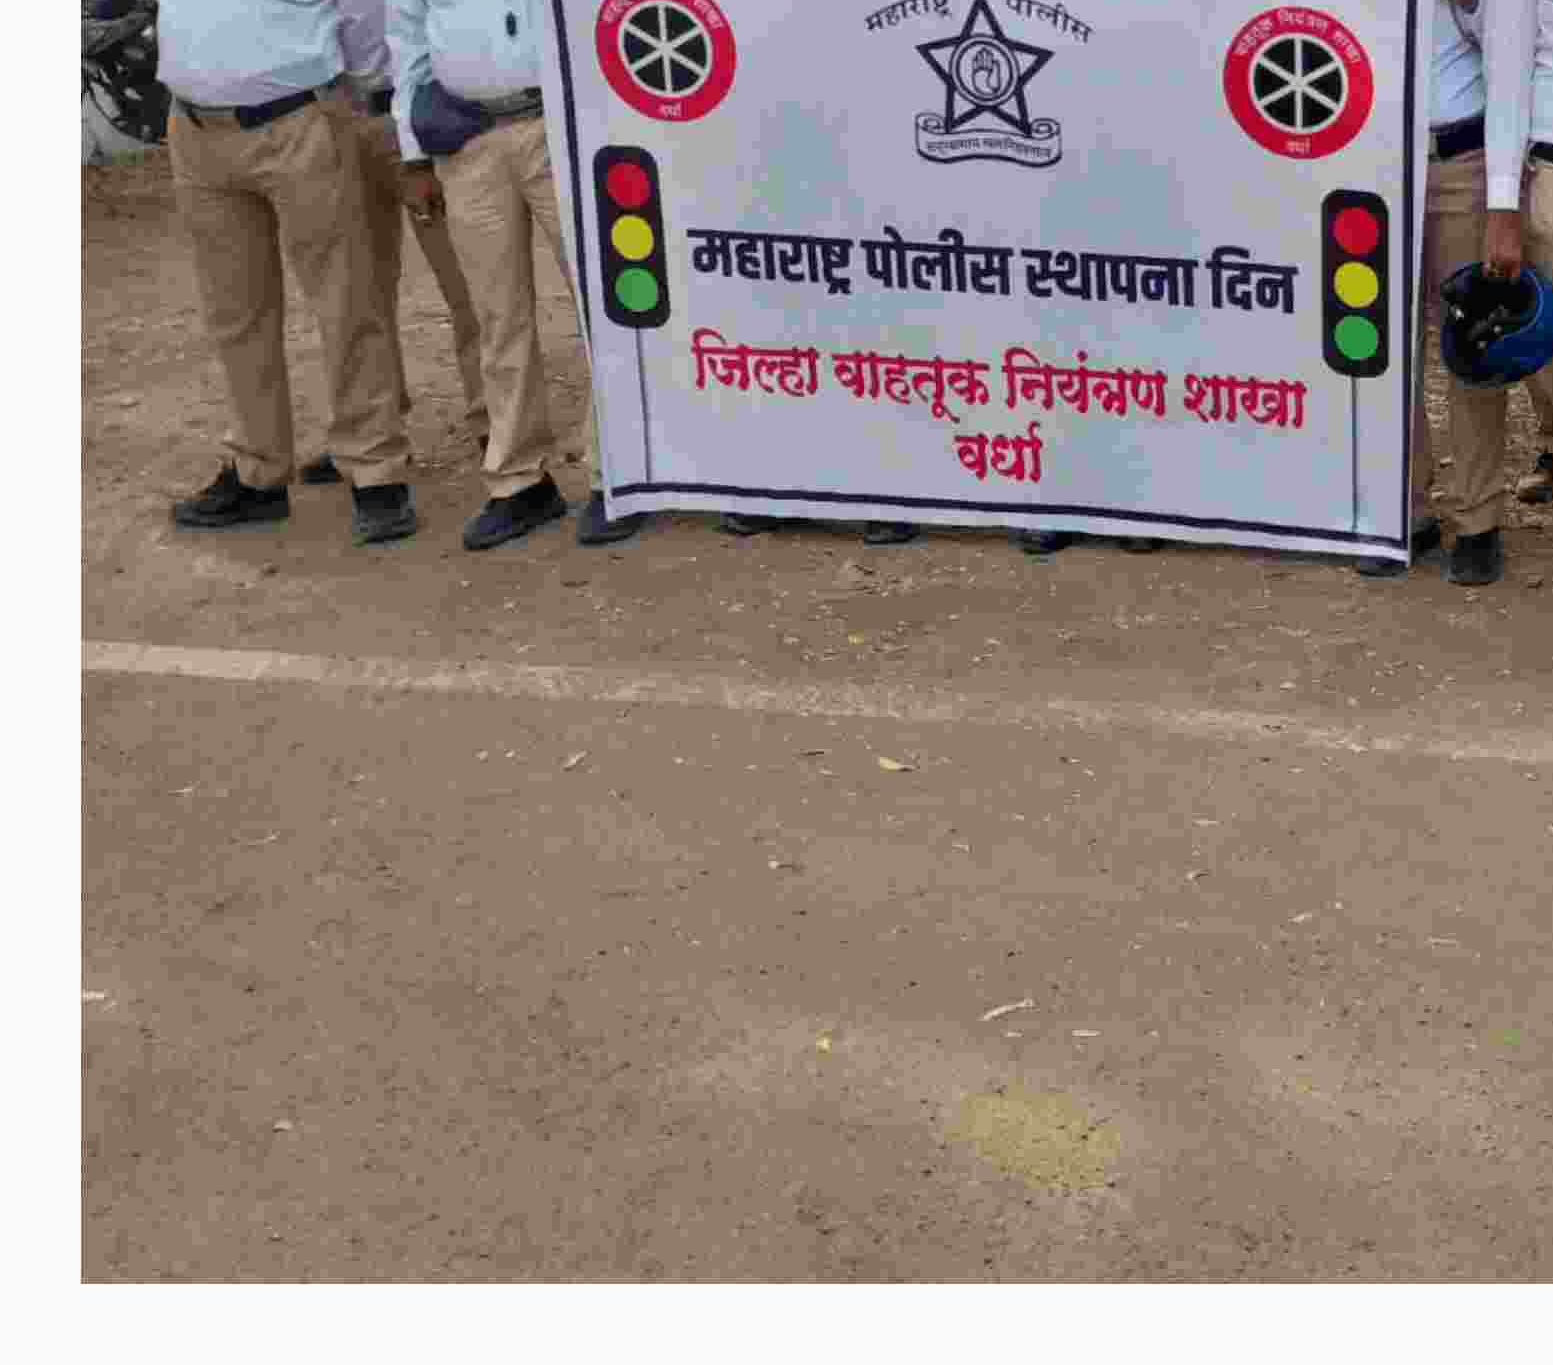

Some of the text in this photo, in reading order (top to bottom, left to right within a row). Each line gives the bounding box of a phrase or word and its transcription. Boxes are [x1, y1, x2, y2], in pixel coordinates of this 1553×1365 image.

[688, 225, 1300, 315] महाराष्ट्र पोलीस स्थापना दिन
[693, 327, 1307, 428] जिल्हा वाहतूक नियंत्रण शाखा
[954, 421, 1042, 483] वर्धा
